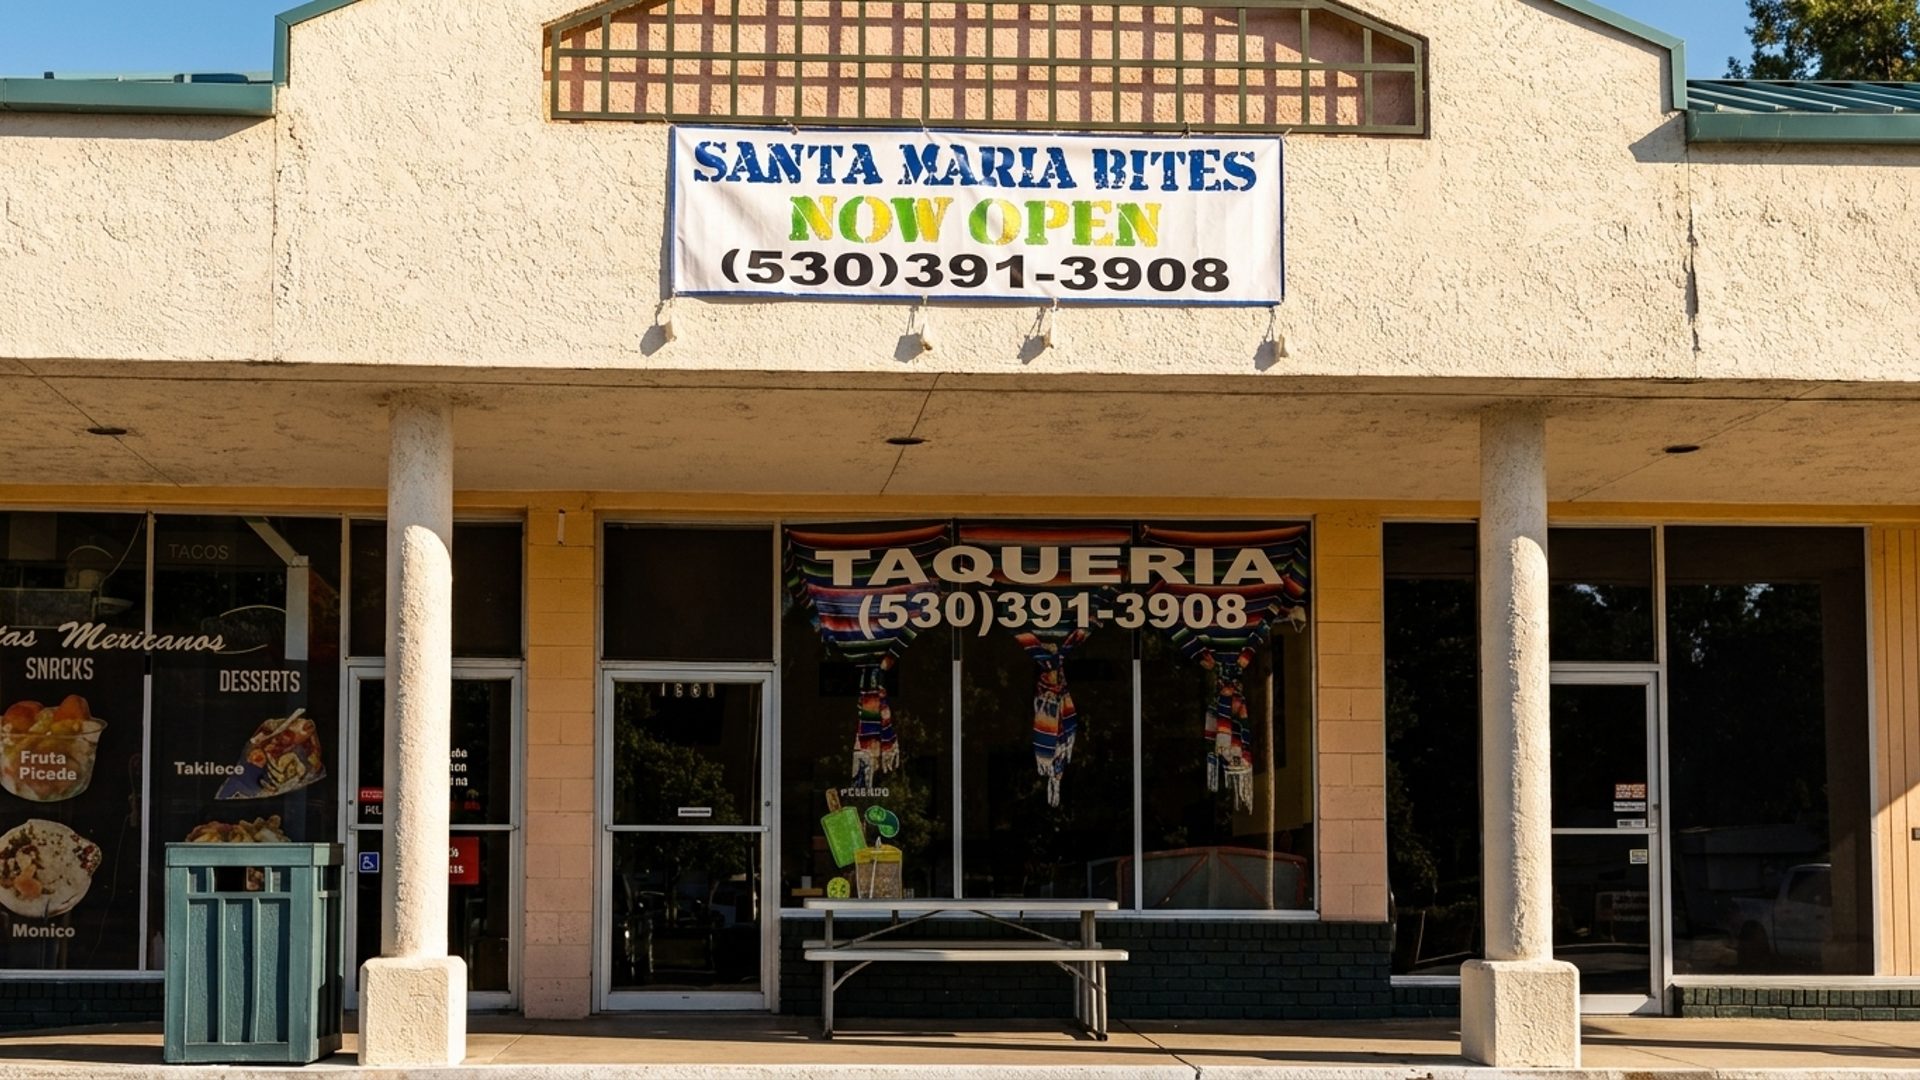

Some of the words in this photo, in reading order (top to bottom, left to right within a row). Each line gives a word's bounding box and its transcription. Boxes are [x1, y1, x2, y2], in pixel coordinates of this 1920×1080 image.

[694, 141, 884, 185] SANTA
[898, 144, 1078, 188] MARIA
[1092, 149, 1258, 192] BITES
[788, 195, 954, 243] NOW
[967, 197, 1162, 248] OPEN
[720, 248, 1230, 293] (530)391-3908
[168, 543, 229, 561] TACOS
[815, 545, 1284, 587] TAQUERIA
[858, 590, 1248, 639] (530)391-3908
[220, 670, 300, 693] DESSERTS
[20, 750, 67, 766] Fruta
[174, 761, 245, 776] Takilece
[19, 767, 77, 782] Picede
[12, 923, 76, 939] Monico
